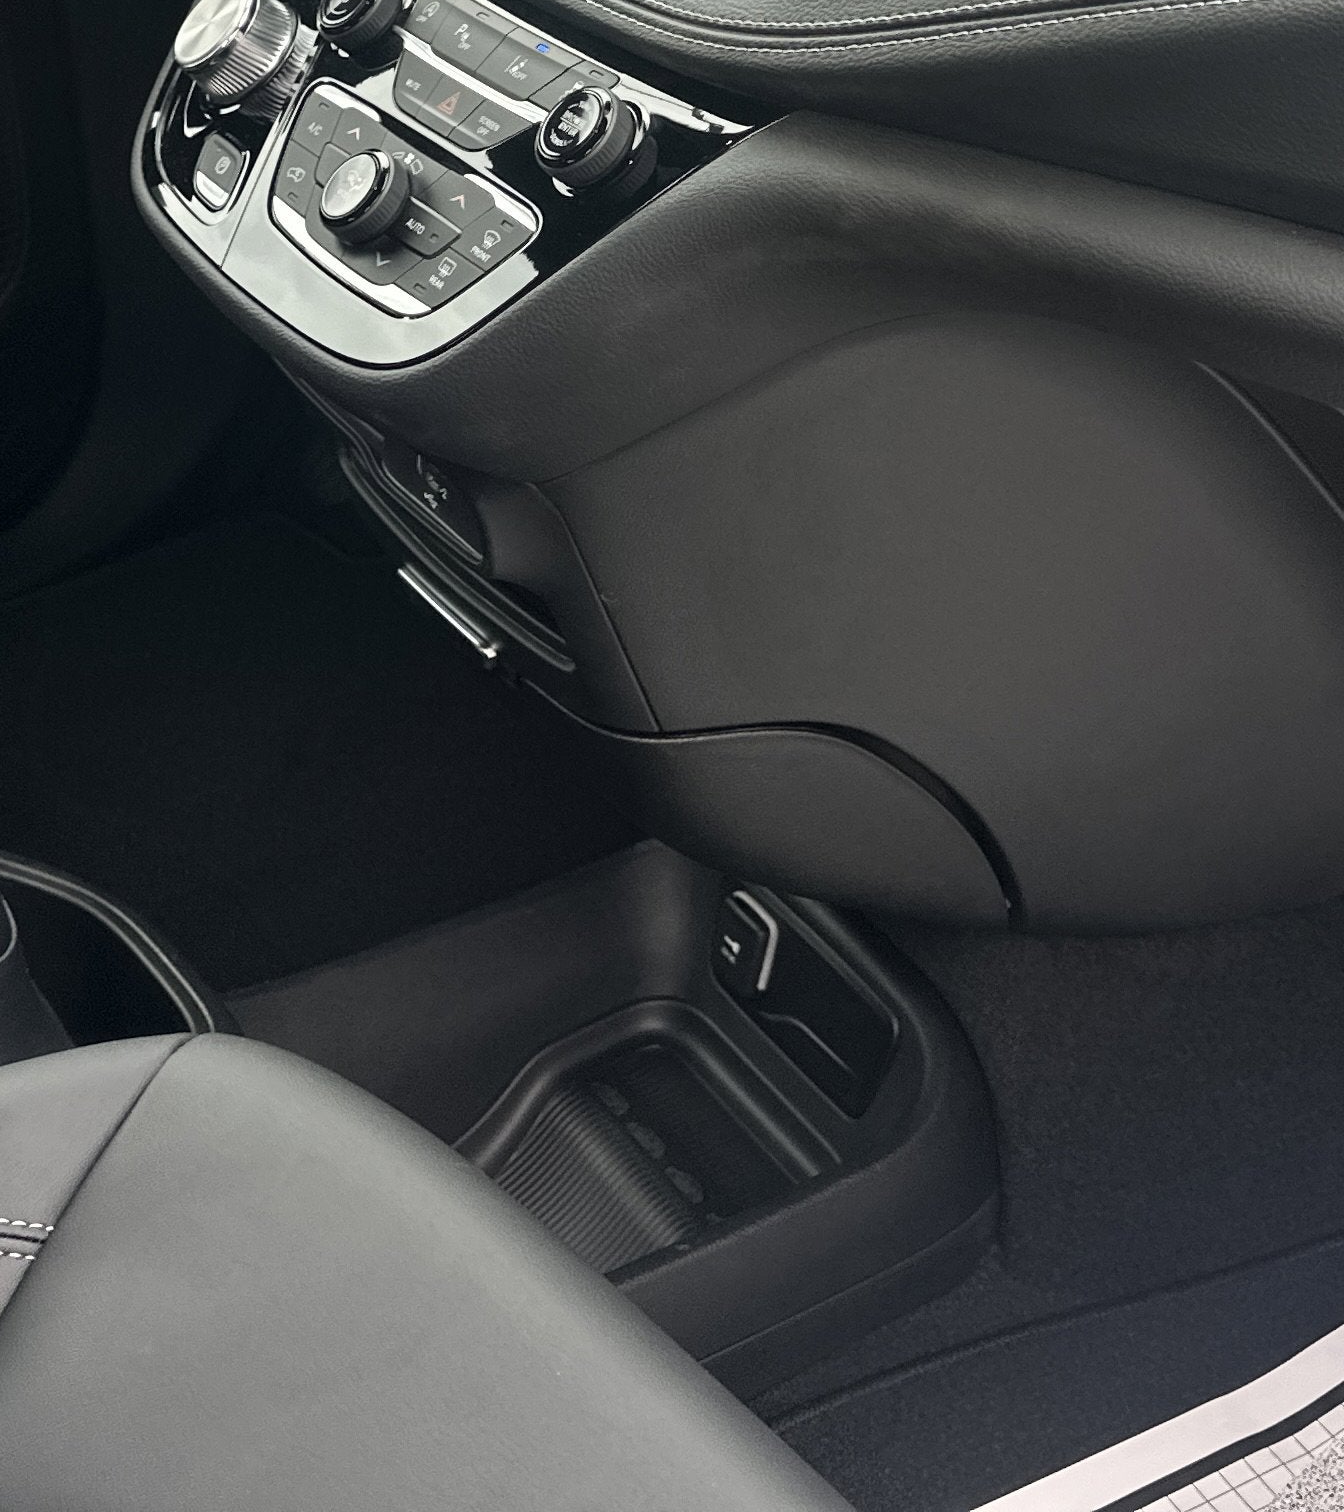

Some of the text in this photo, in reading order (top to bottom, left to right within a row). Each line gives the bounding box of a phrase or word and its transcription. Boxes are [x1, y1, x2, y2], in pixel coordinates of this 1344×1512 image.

[307, 121, 323, 136] A/C
[405, 217, 426, 235] AUTO
[469, 245, 492, 263] FRONT
[428, 274, 446, 290] REAR
